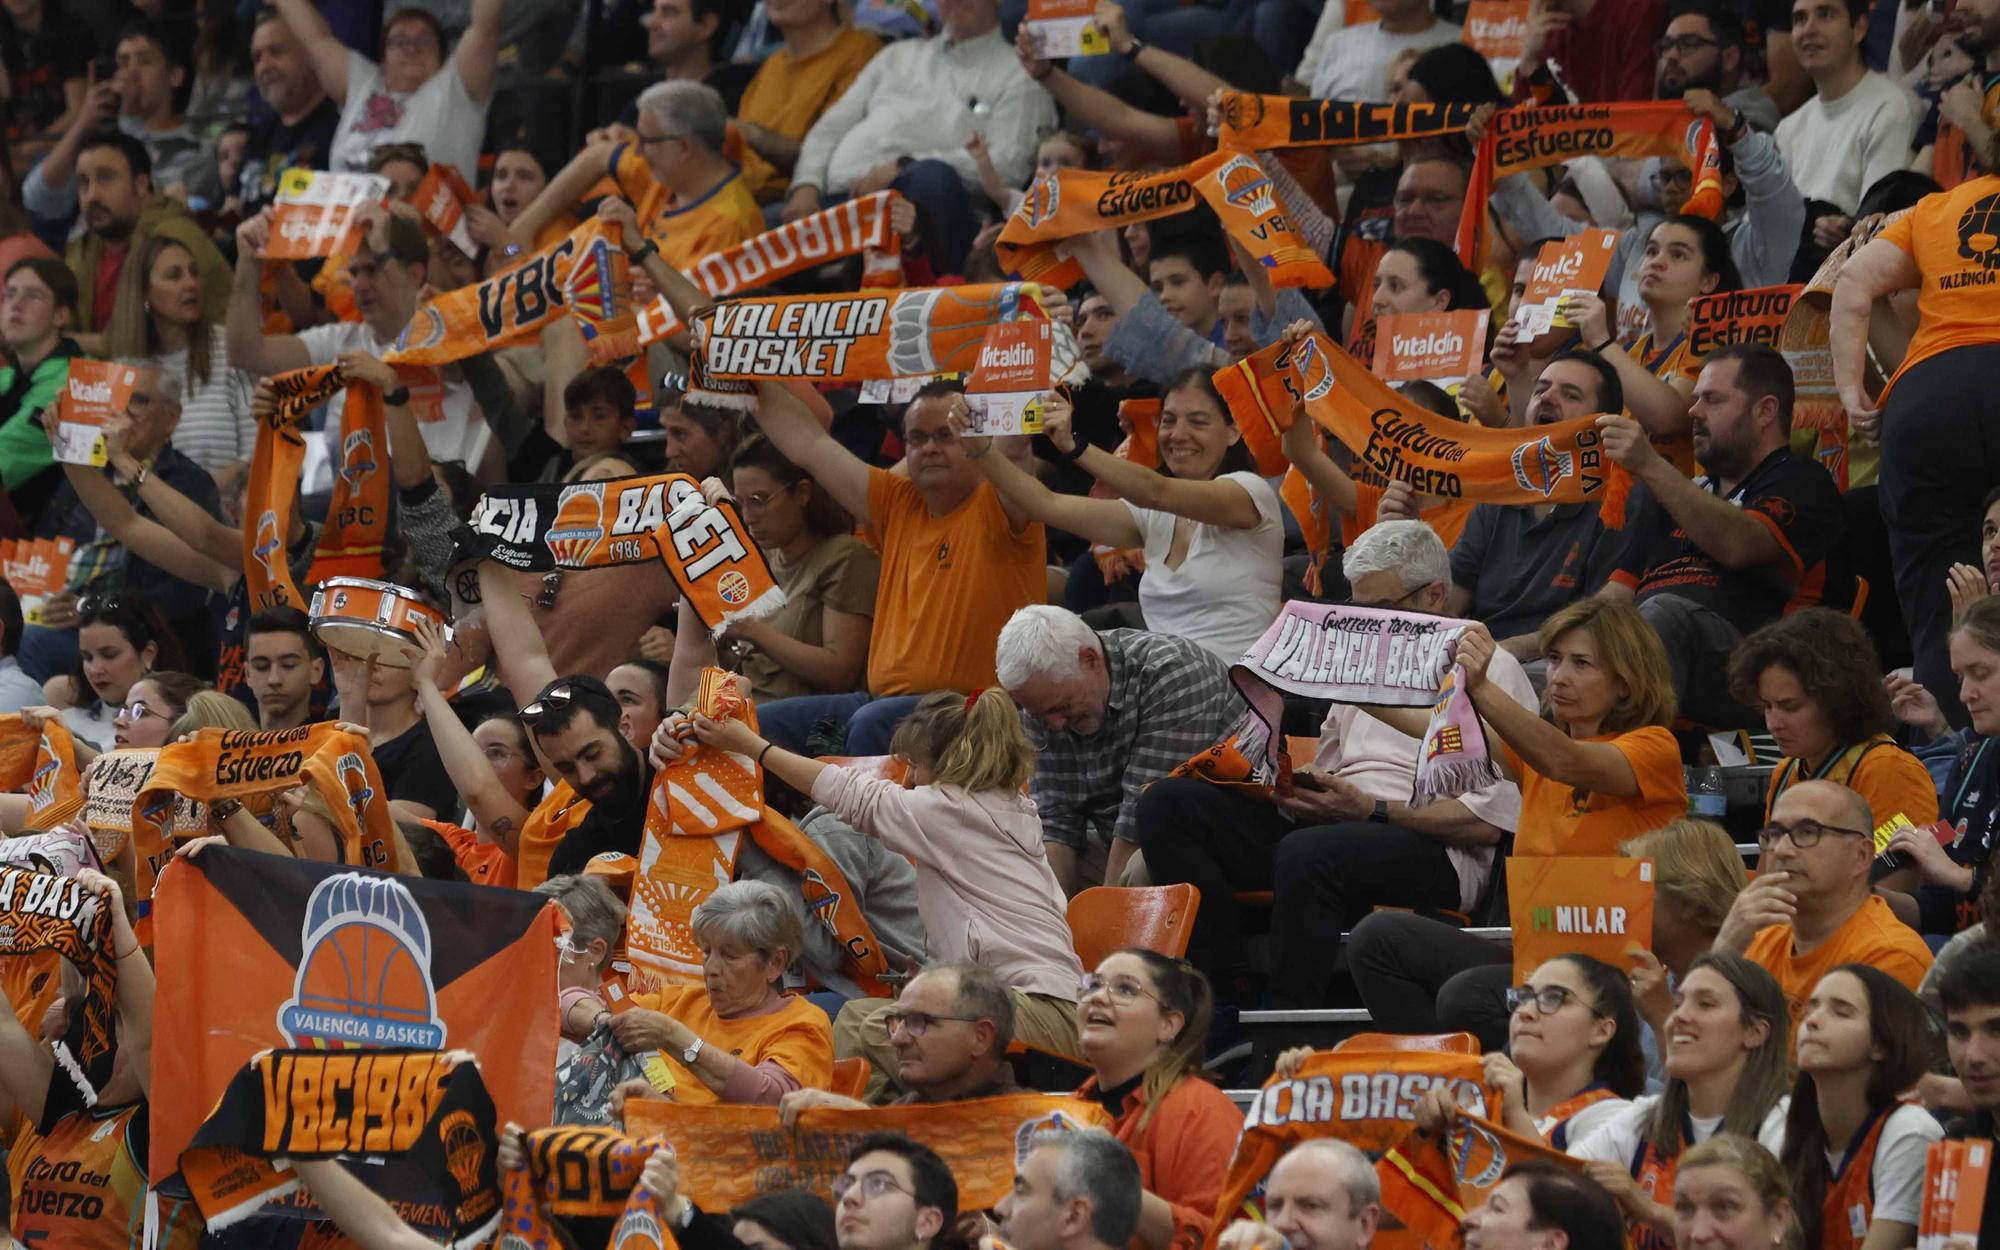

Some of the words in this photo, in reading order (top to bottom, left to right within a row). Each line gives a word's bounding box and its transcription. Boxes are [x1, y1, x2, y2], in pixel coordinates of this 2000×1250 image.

[1496, 127, 1614, 167] Esfuerzo
[1097, 179, 1193, 218] Esfuerzo
[479, 238, 573, 338] VBC
[712, 298, 888, 338] VALENCIA
[1694, 292, 1792, 325] Cultura
[708, 337, 856, 377] BASKET
[982, 342, 1034, 368] Vitaldin
[1392, 330, 1463, 357] Vitaldin
[1371, 408, 1449, 459] Cultura
[1363, 431, 1463, 500] Esfuerzo
[1575, 428, 1604, 495] VBC
[609, 539, 641, 561] 1986
[1322, 611, 1384, 633] Guerreres
[1261, 613, 1381, 685] VALENCIA
[215, 750, 304, 785] Esfuerzo
[1555, 905, 1627, 935] MILAR
[294, 1013, 370, 1039] VALENCIA
[375, 1024, 435, 1047] BASKET
[79, 1170, 111, 1188] del
